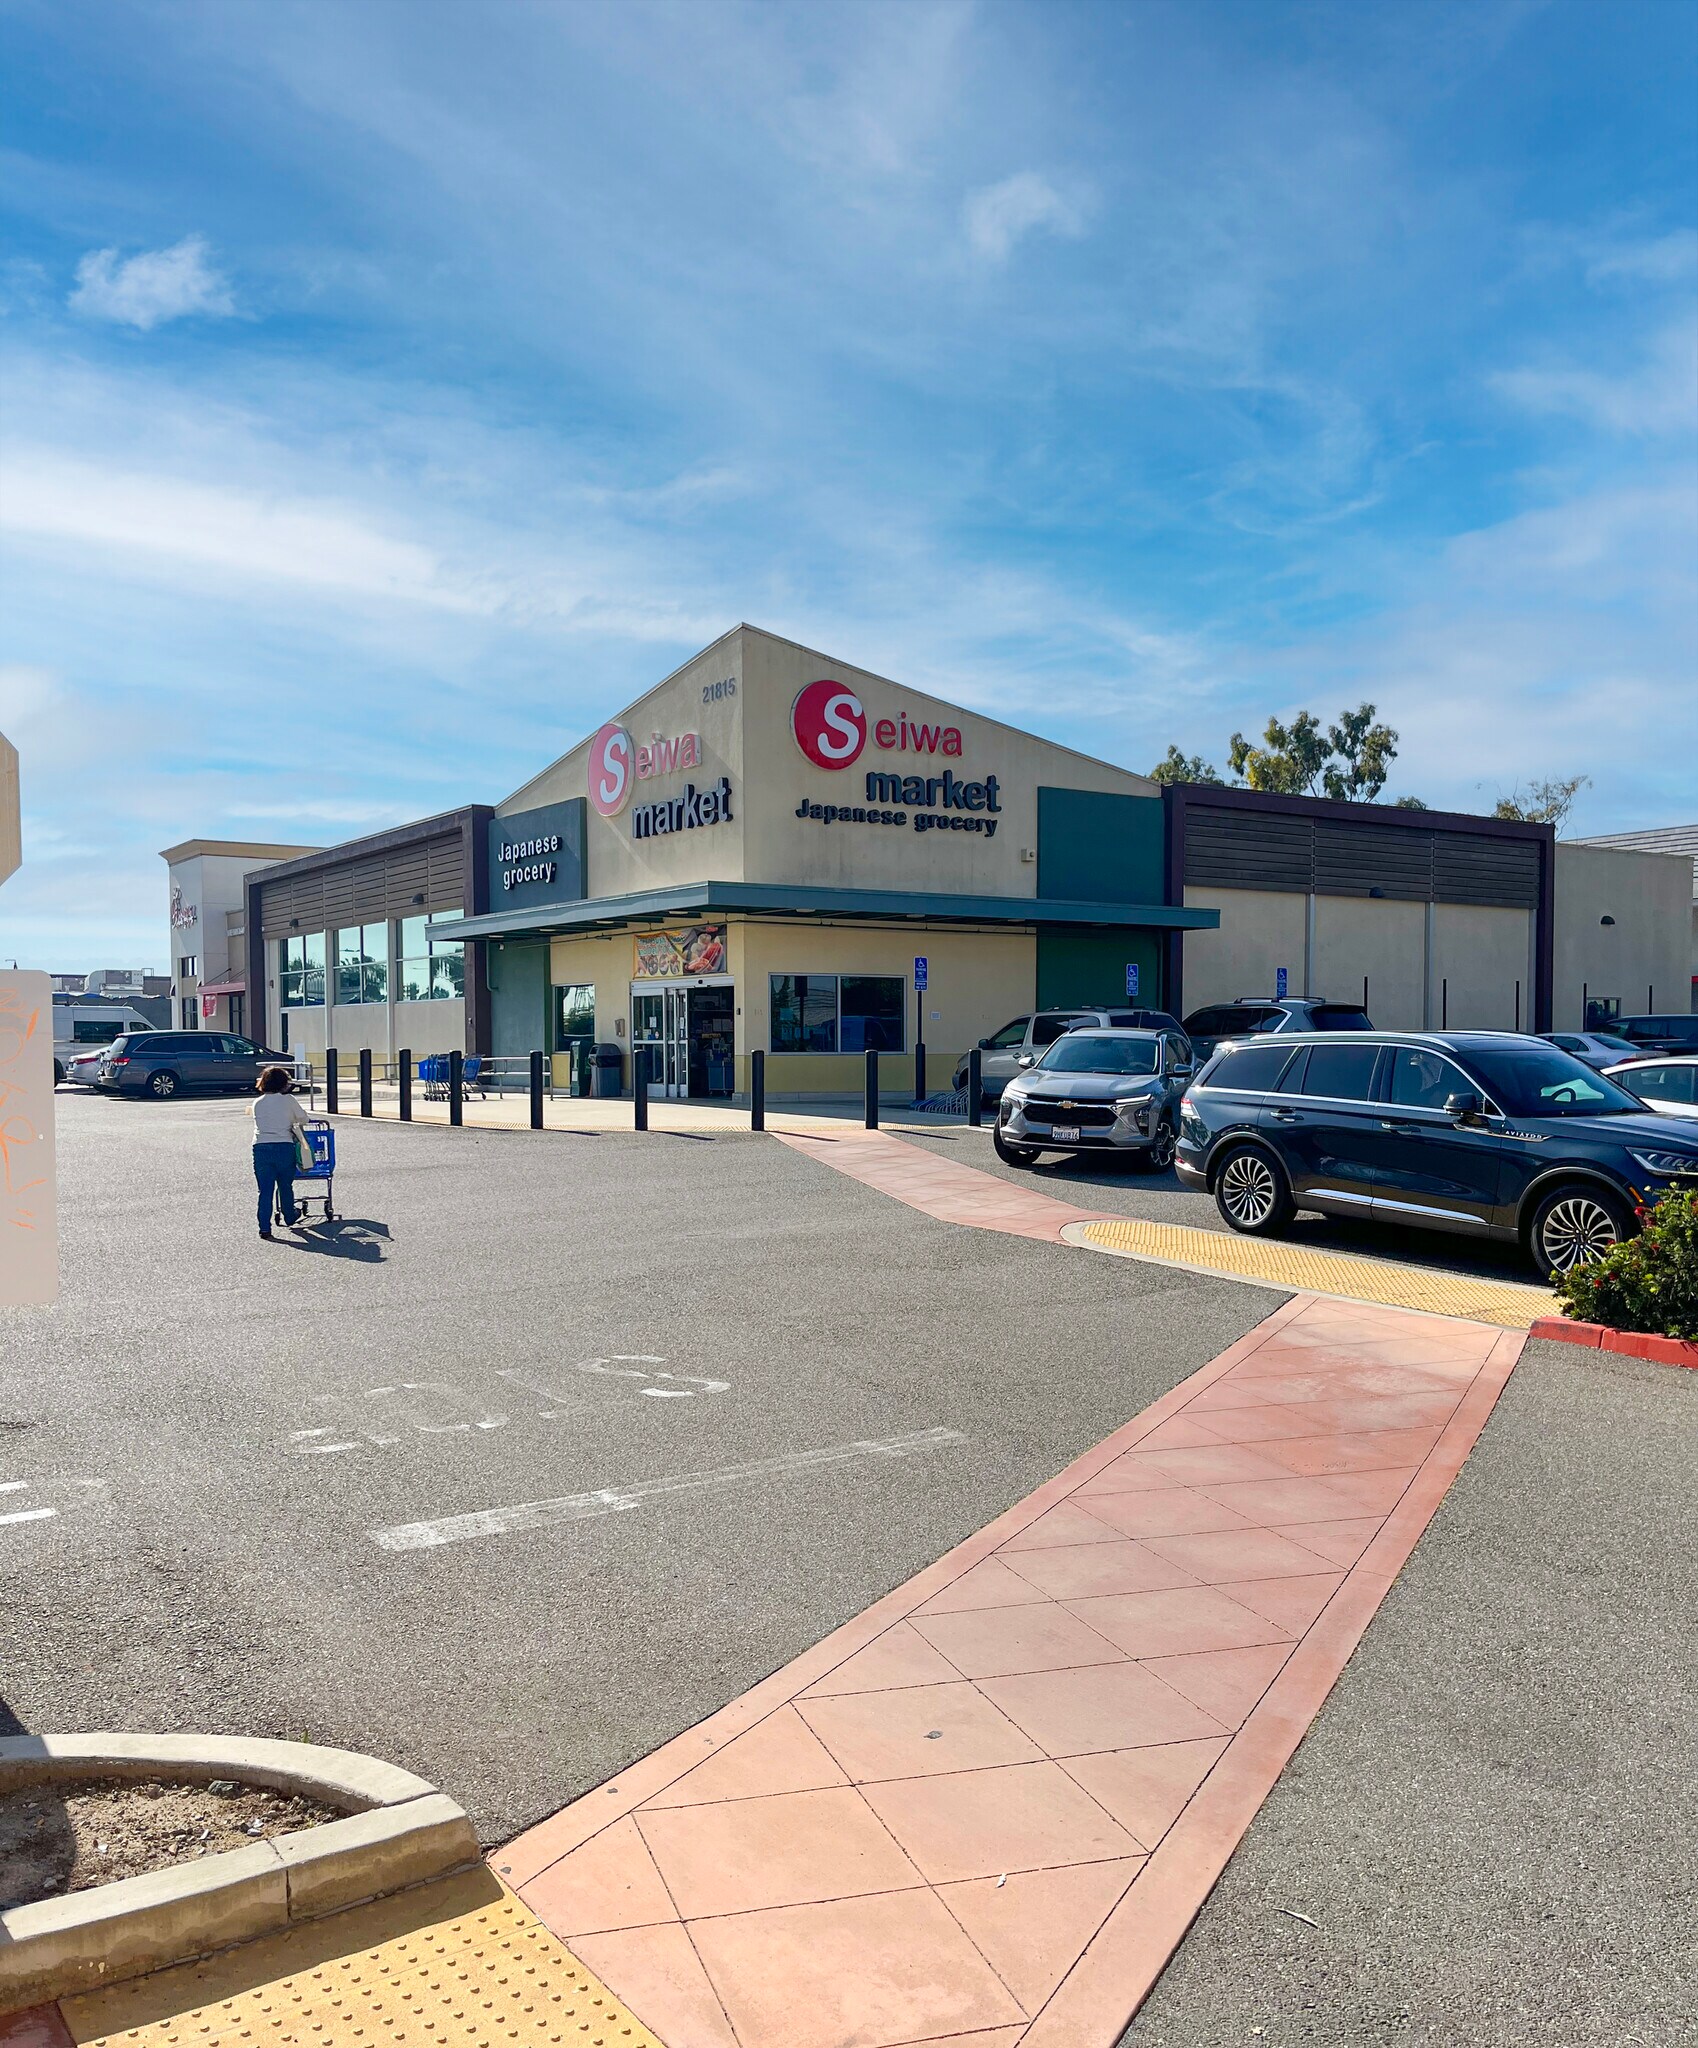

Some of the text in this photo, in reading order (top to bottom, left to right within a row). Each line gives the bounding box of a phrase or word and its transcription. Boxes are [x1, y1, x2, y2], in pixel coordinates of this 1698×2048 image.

[702, 677, 735, 703] 21815
[815, 693, 963, 759] Seiwa
[599, 732, 702, 804] Seiwa
[632, 777, 733, 838] market
[866, 770, 1001, 812] market
[795, 798, 998, 837] Japanese grocery
[498, 834, 562, 864] Japanese
[503, 861, 556, 890] grocery
[1505, 1130, 1542, 1139] AVIATOR
